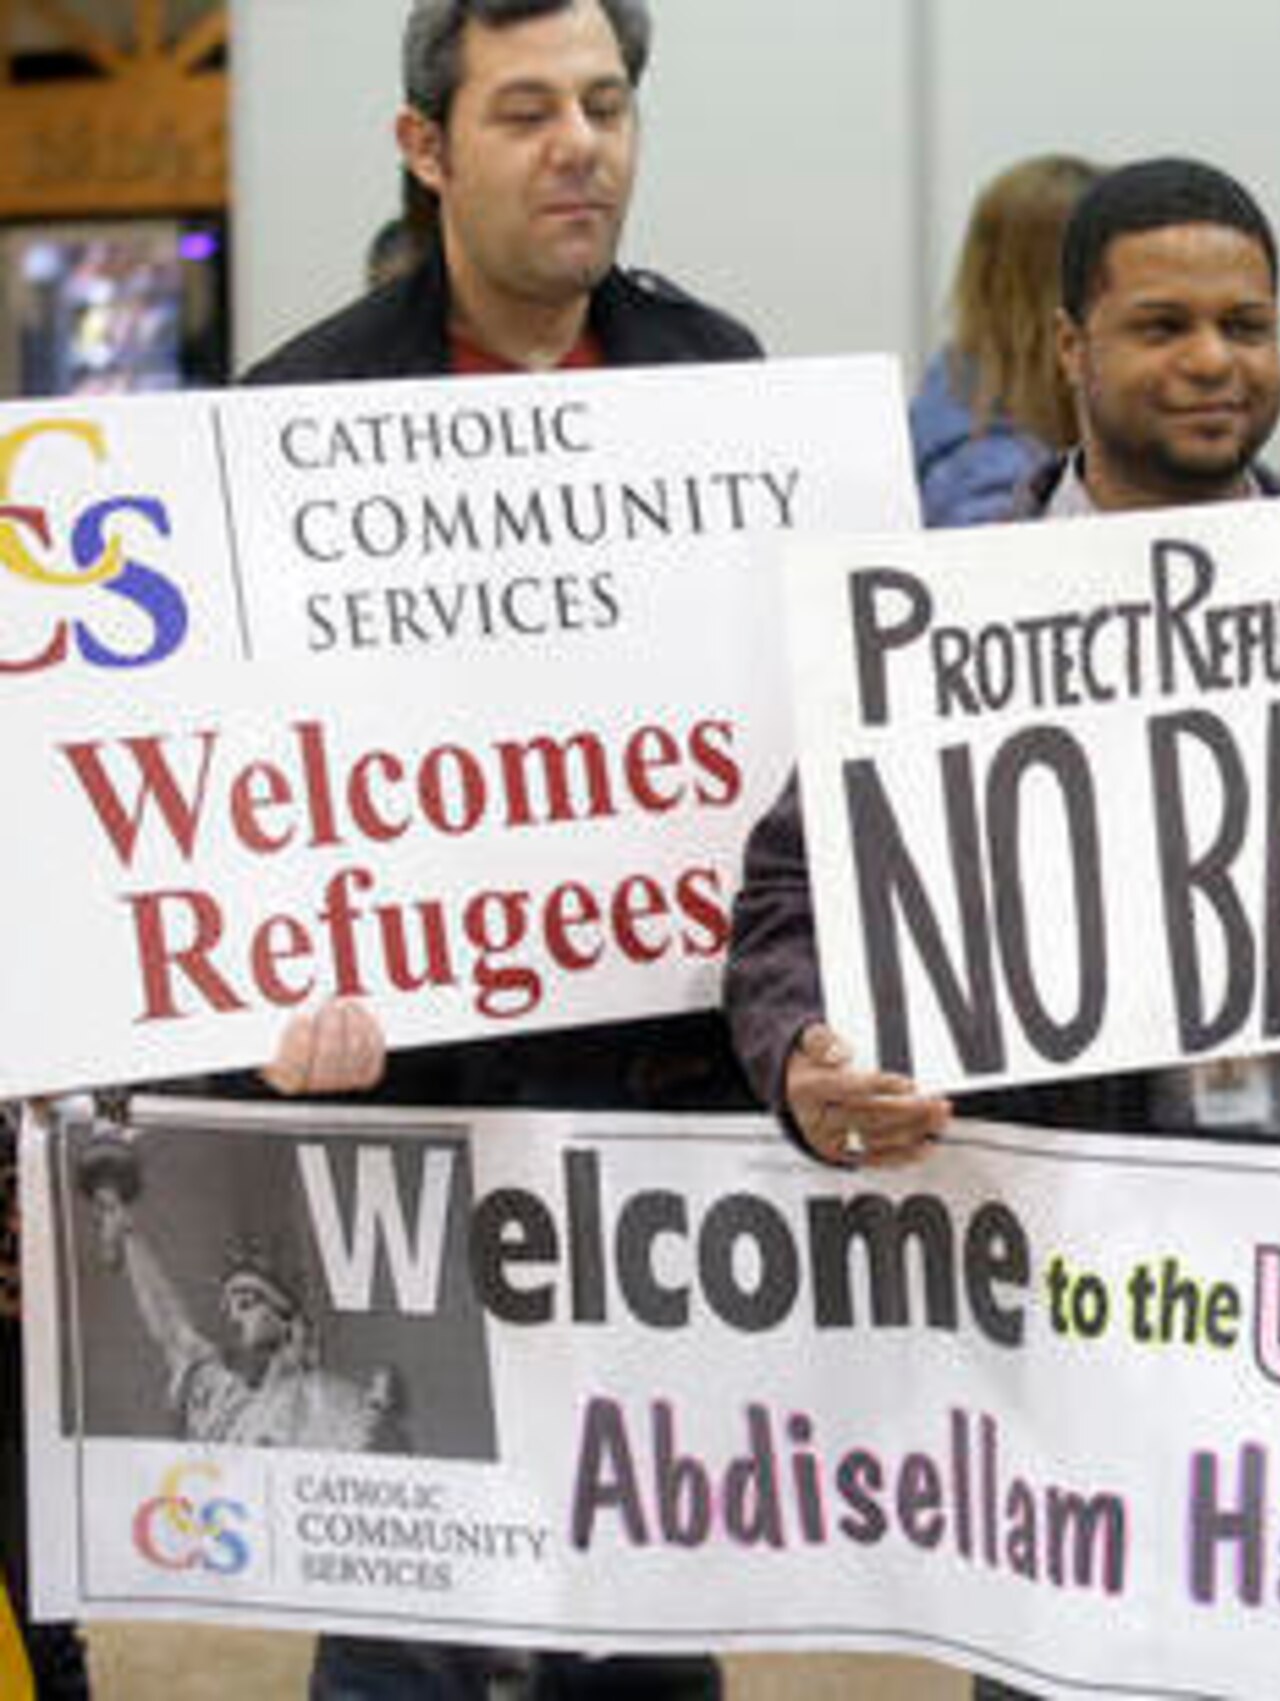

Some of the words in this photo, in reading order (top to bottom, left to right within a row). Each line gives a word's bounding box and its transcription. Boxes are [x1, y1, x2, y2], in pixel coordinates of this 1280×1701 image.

[278, 401, 594, 470] CATHOLIC
[293, 469, 801, 562] COMMUNITY
[306, 570, 623, 652] SERVICES
[55, 718, 743, 868] Welcomes
[120, 865, 733, 1024] Refugees
[842, 724, 1109, 1078] NO
[297, 1143, 1031, 1348] Welcome
[1043, 1255, 1111, 1341] to
[1125, 1256, 1241, 1348] the
[294, 1474, 446, 1513] CATHOLIC
[296, 1511, 550, 1561] COMMUNITY
[568, 1394, 1130, 1598] Abdisellam
[300, 1552, 455, 1592] SERVICES
